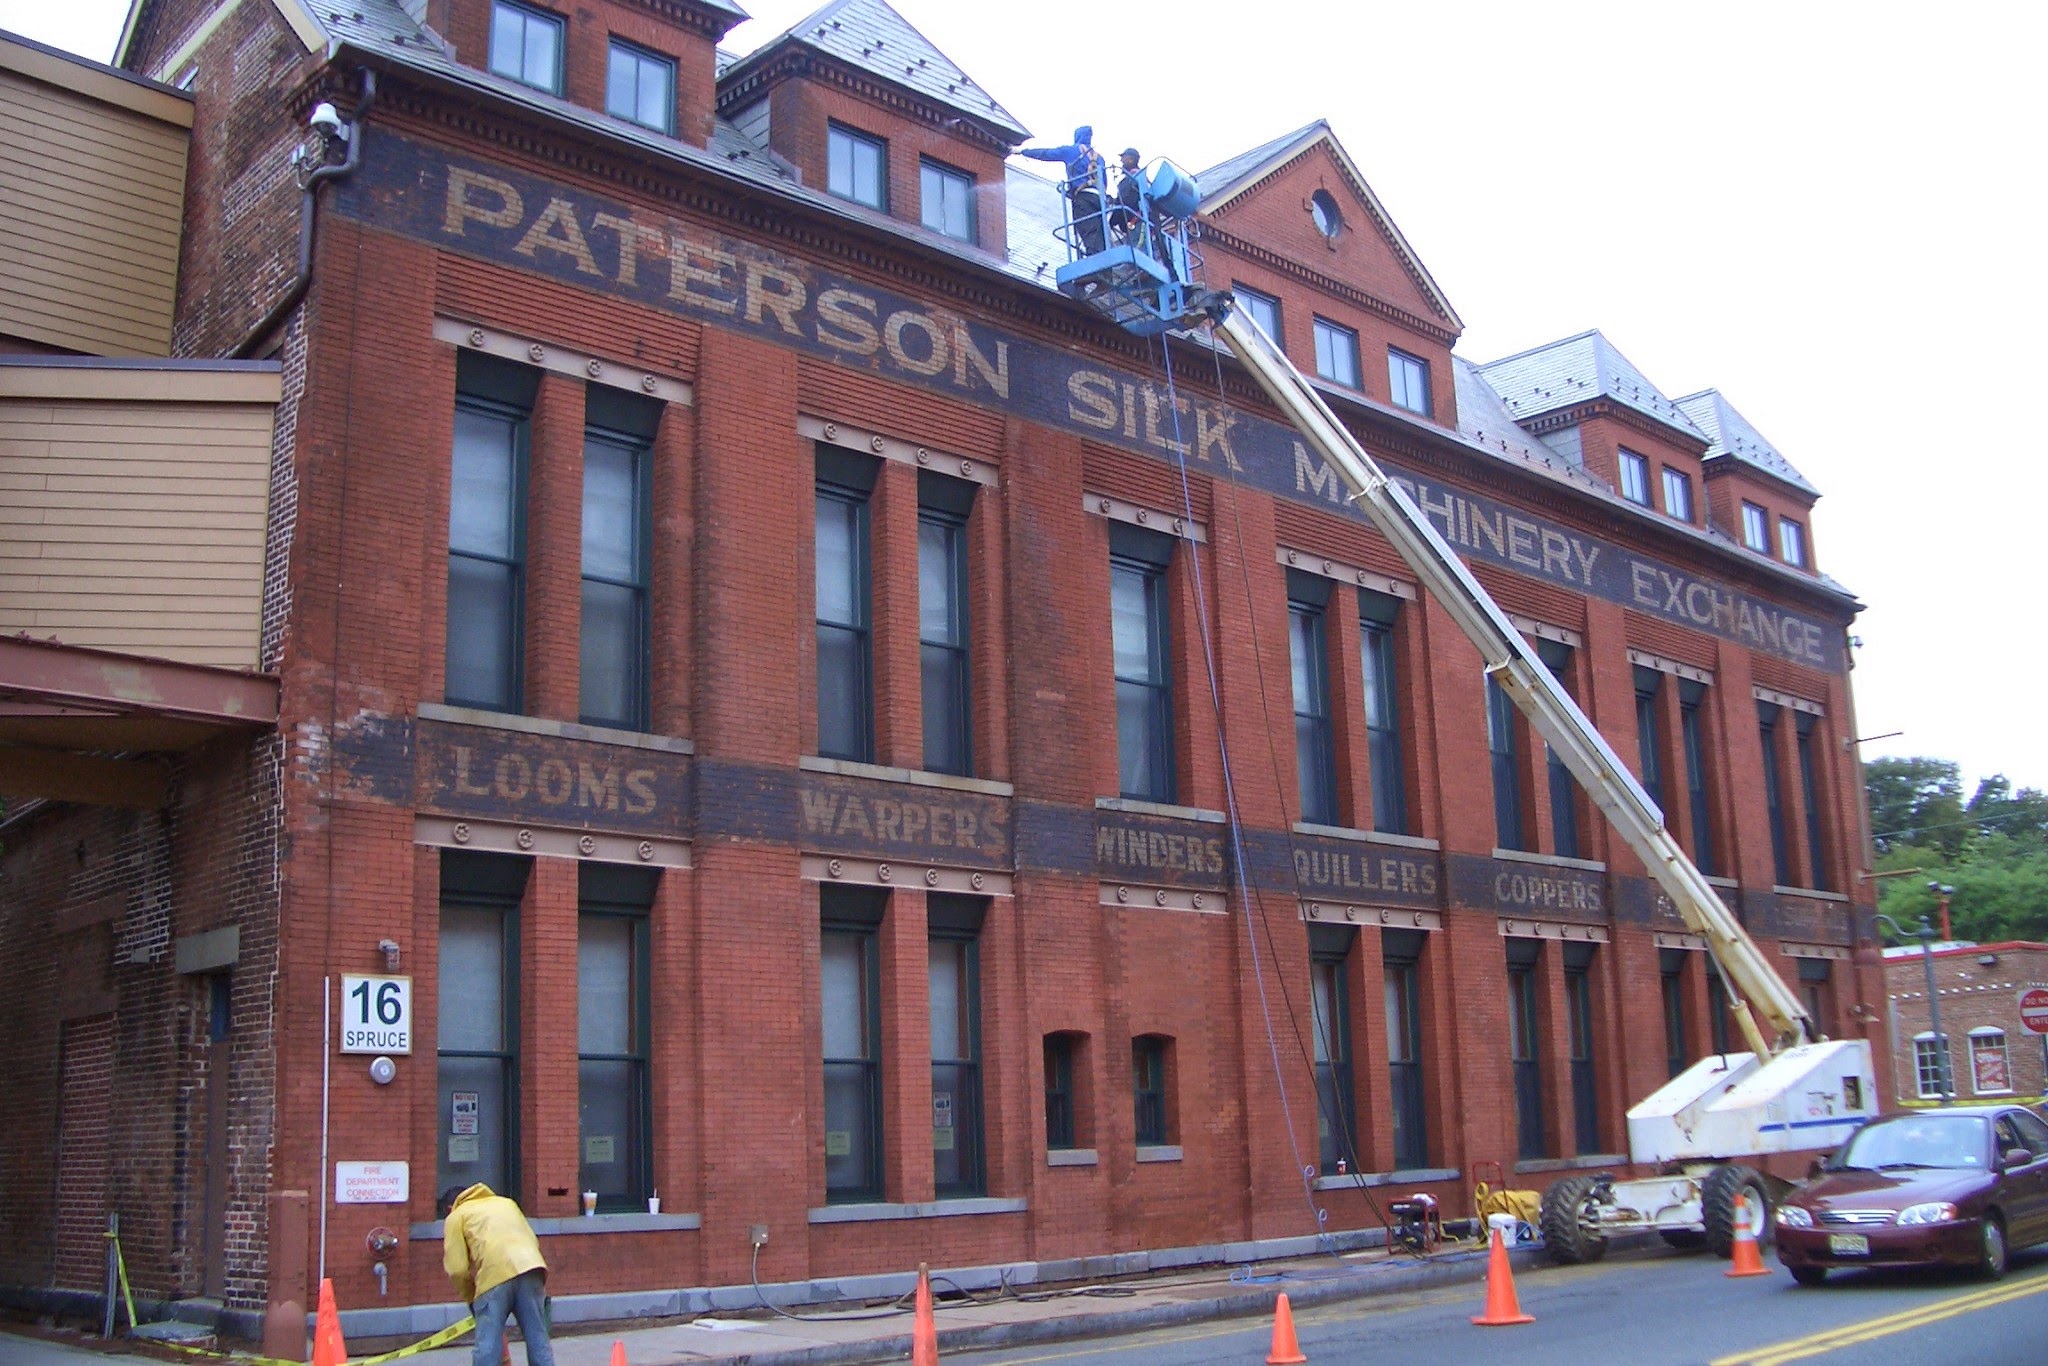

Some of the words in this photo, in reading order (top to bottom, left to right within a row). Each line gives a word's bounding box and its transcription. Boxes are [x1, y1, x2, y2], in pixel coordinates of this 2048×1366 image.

[440, 164, 1008, 399] PATERSON
[1067, 370, 1243, 472] SILK
[1293, 441, 1600, 587] MHINERY
[1629, 560, 1825, 663] EXCHANGE
[455, 746, 657, 814] LOOMS
[800, 789, 1009, 855] WARPERS
[1099, 826, 1225, 874] WINDERS
[1293, 849, 1437, 895] QUILLERS
[1494, 872, 1600, 911] COPPERS
[352, 981, 402, 1025] 16
[346, 1031, 407, 1047] SPRUCE
[364, 1166, 382, 1174] FIRE
[346, 1177, 399, 1186] DEPARTMENT
[346, 1188, 399, 1197] CONNECTION
